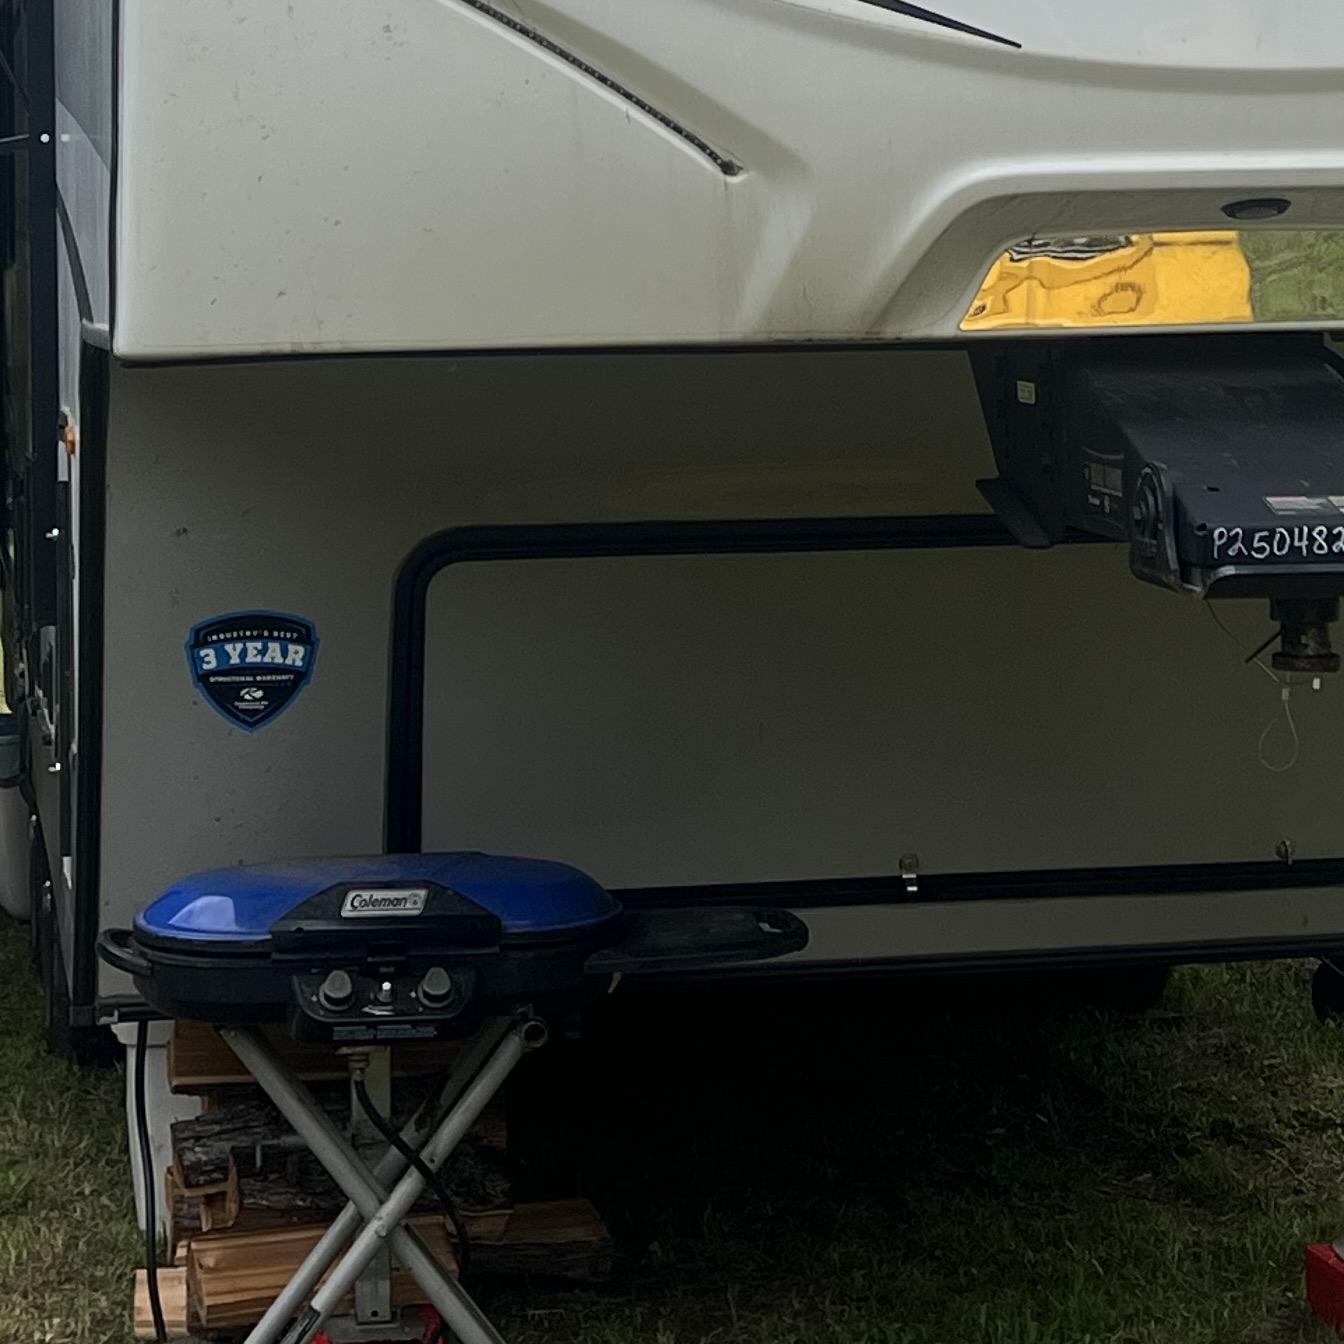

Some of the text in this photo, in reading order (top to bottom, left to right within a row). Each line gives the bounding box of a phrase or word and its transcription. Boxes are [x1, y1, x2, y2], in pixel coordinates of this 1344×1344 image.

[199, 642, 305, 670] 3 YEAR
[350, 893, 408, 909] Coleman
